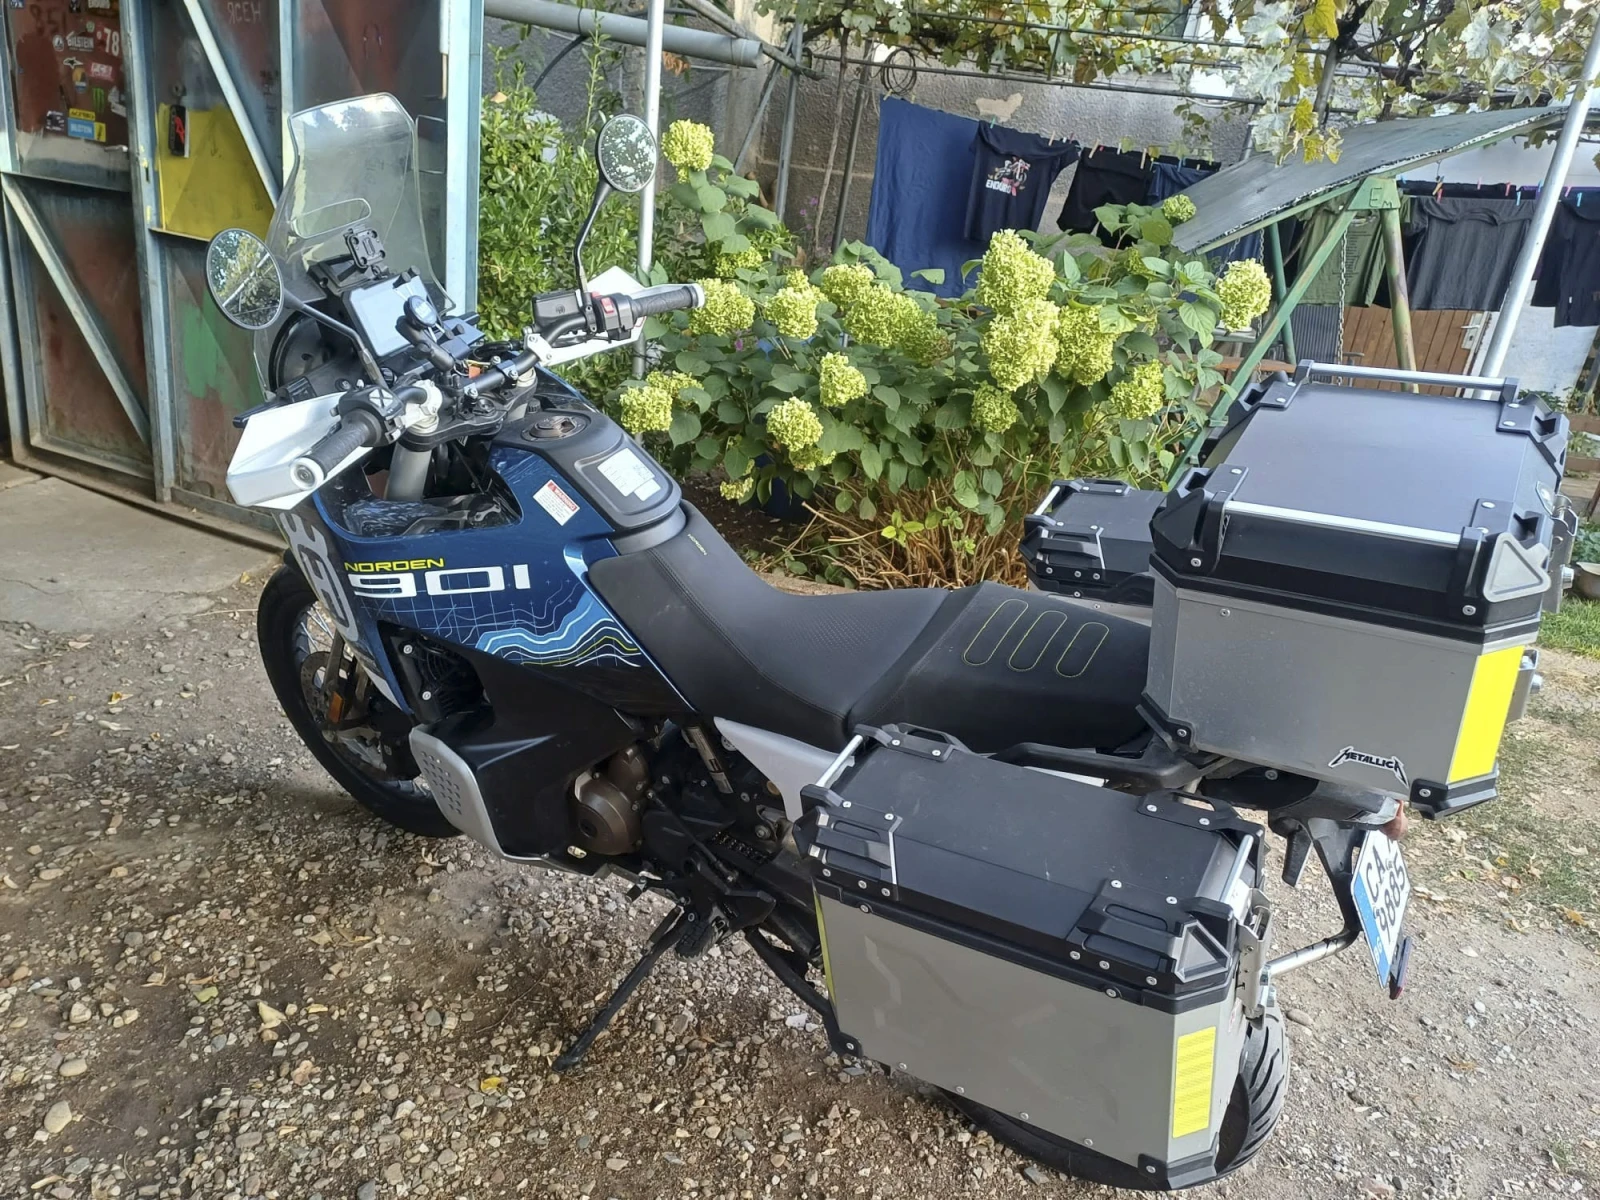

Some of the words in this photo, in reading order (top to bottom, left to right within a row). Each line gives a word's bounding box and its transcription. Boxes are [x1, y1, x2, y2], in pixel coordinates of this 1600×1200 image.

[344, 557, 444, 573] NORDEN
[347, 564, 531, 599] 901
[1330, 747, 1408, 787] METALLICA
